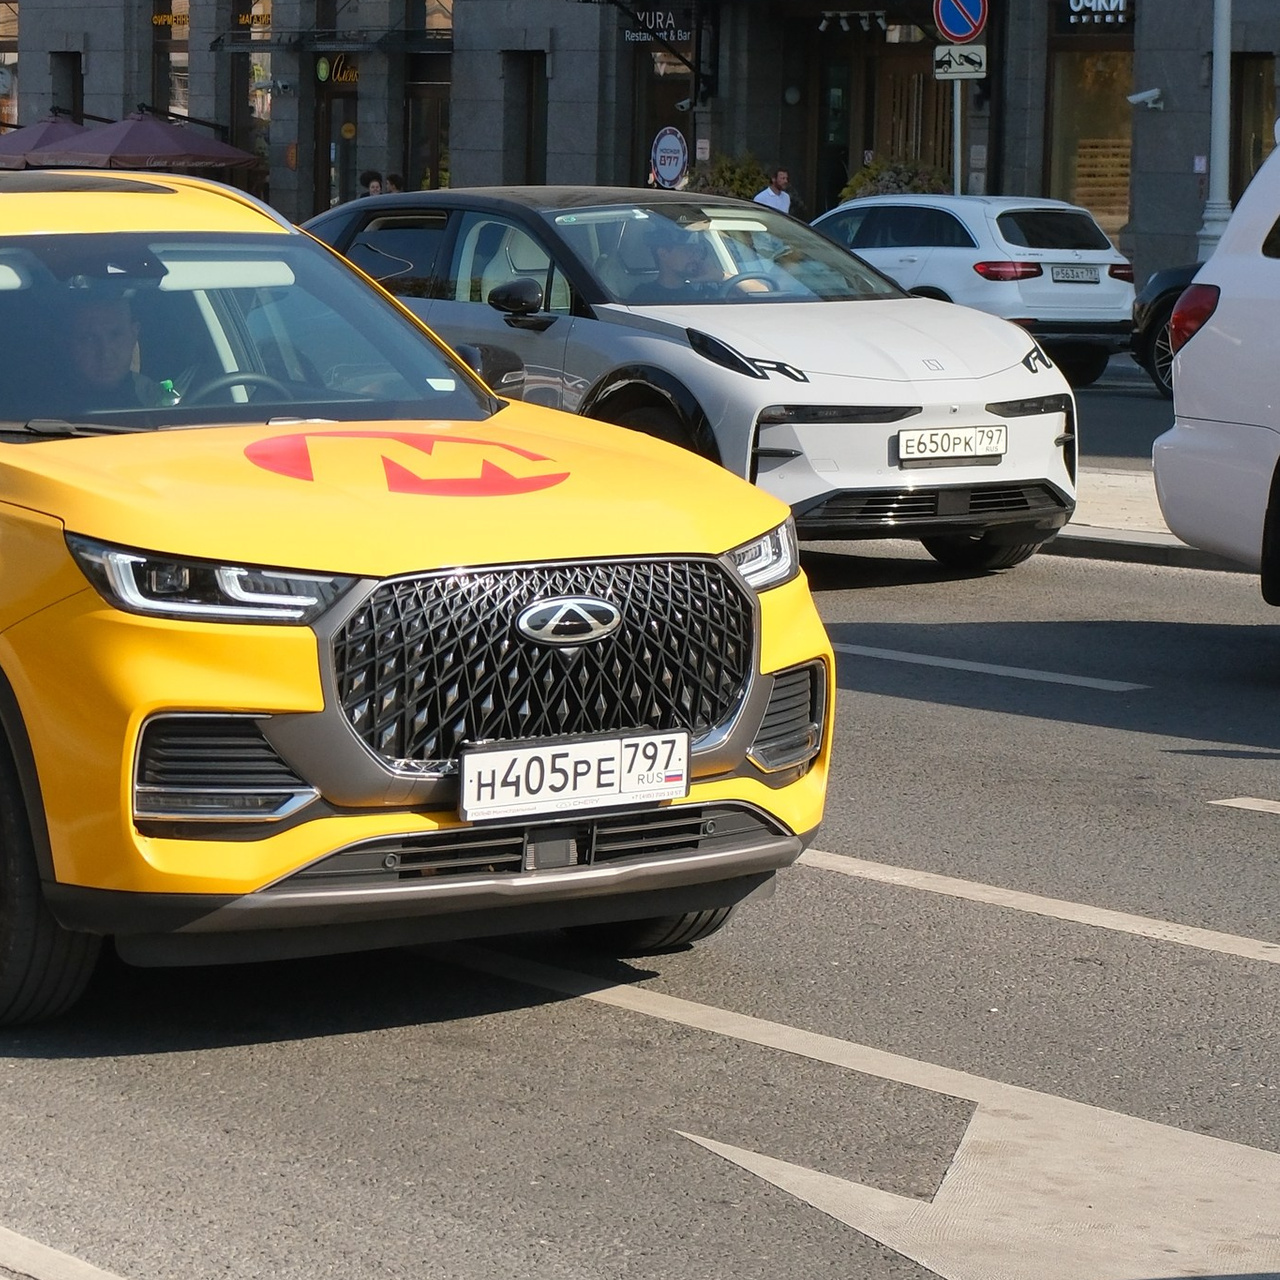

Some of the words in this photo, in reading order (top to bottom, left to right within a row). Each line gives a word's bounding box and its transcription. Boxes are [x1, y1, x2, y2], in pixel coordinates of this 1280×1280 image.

[636, 11, 675, 29] YURA
[669, 30, 675, 41] &
[677, 29, 691, 41] Bar
[977, 428, 1003, 447] 797
[985, 445, 999, 453] RUS
[624, 739, 676, 774] 797
[638, 771, 664, 785] RUS
[573, 798, 600, 807] CHERY
